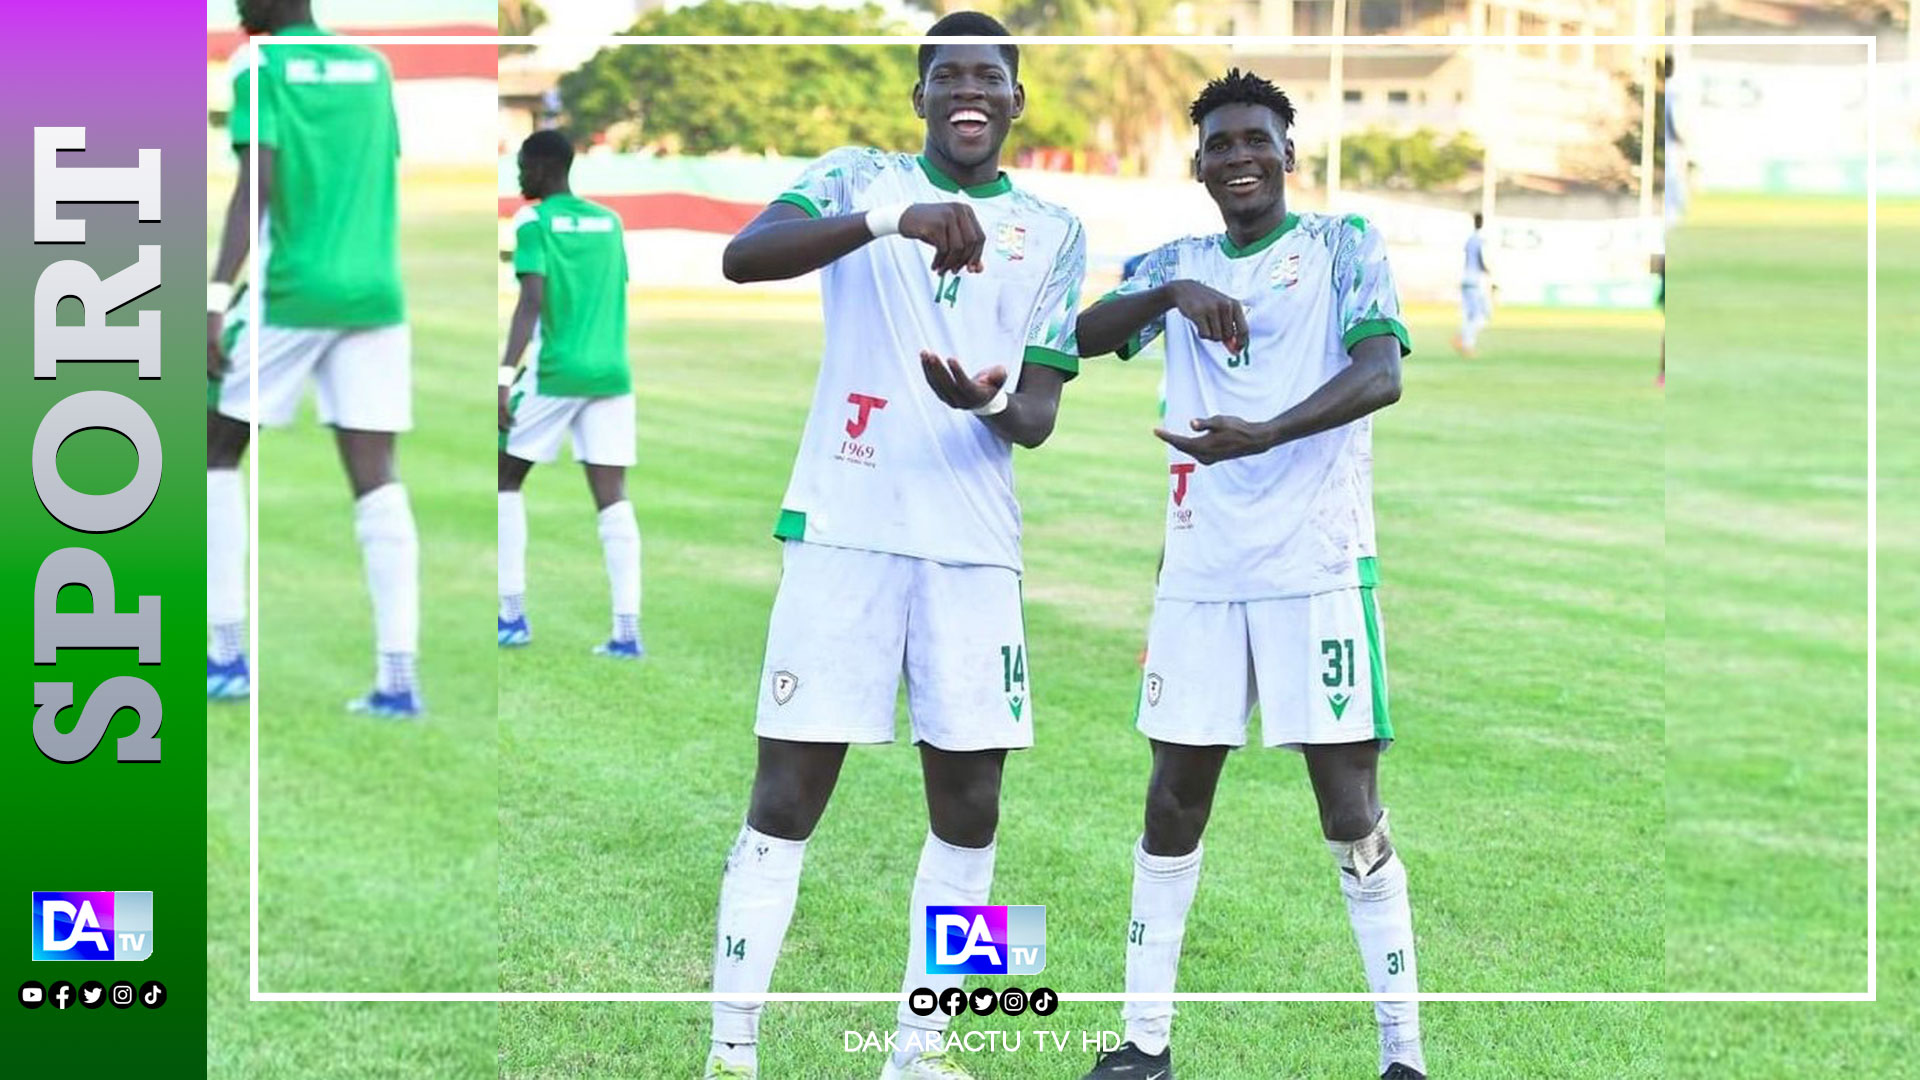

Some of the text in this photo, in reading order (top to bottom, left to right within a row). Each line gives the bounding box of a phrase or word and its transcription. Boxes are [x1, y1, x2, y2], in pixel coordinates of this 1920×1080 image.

[934, 275, 961, 308] 14
[840, 441, 875, 459] 1969
[1001, 644, 1024, 692] 14
[1321, 639, 1354, 687] 31
[1130, 921, 1145, 946] 31
[725, 935, 746, 961] 14
[1387, 949, 1405, 976] 31
